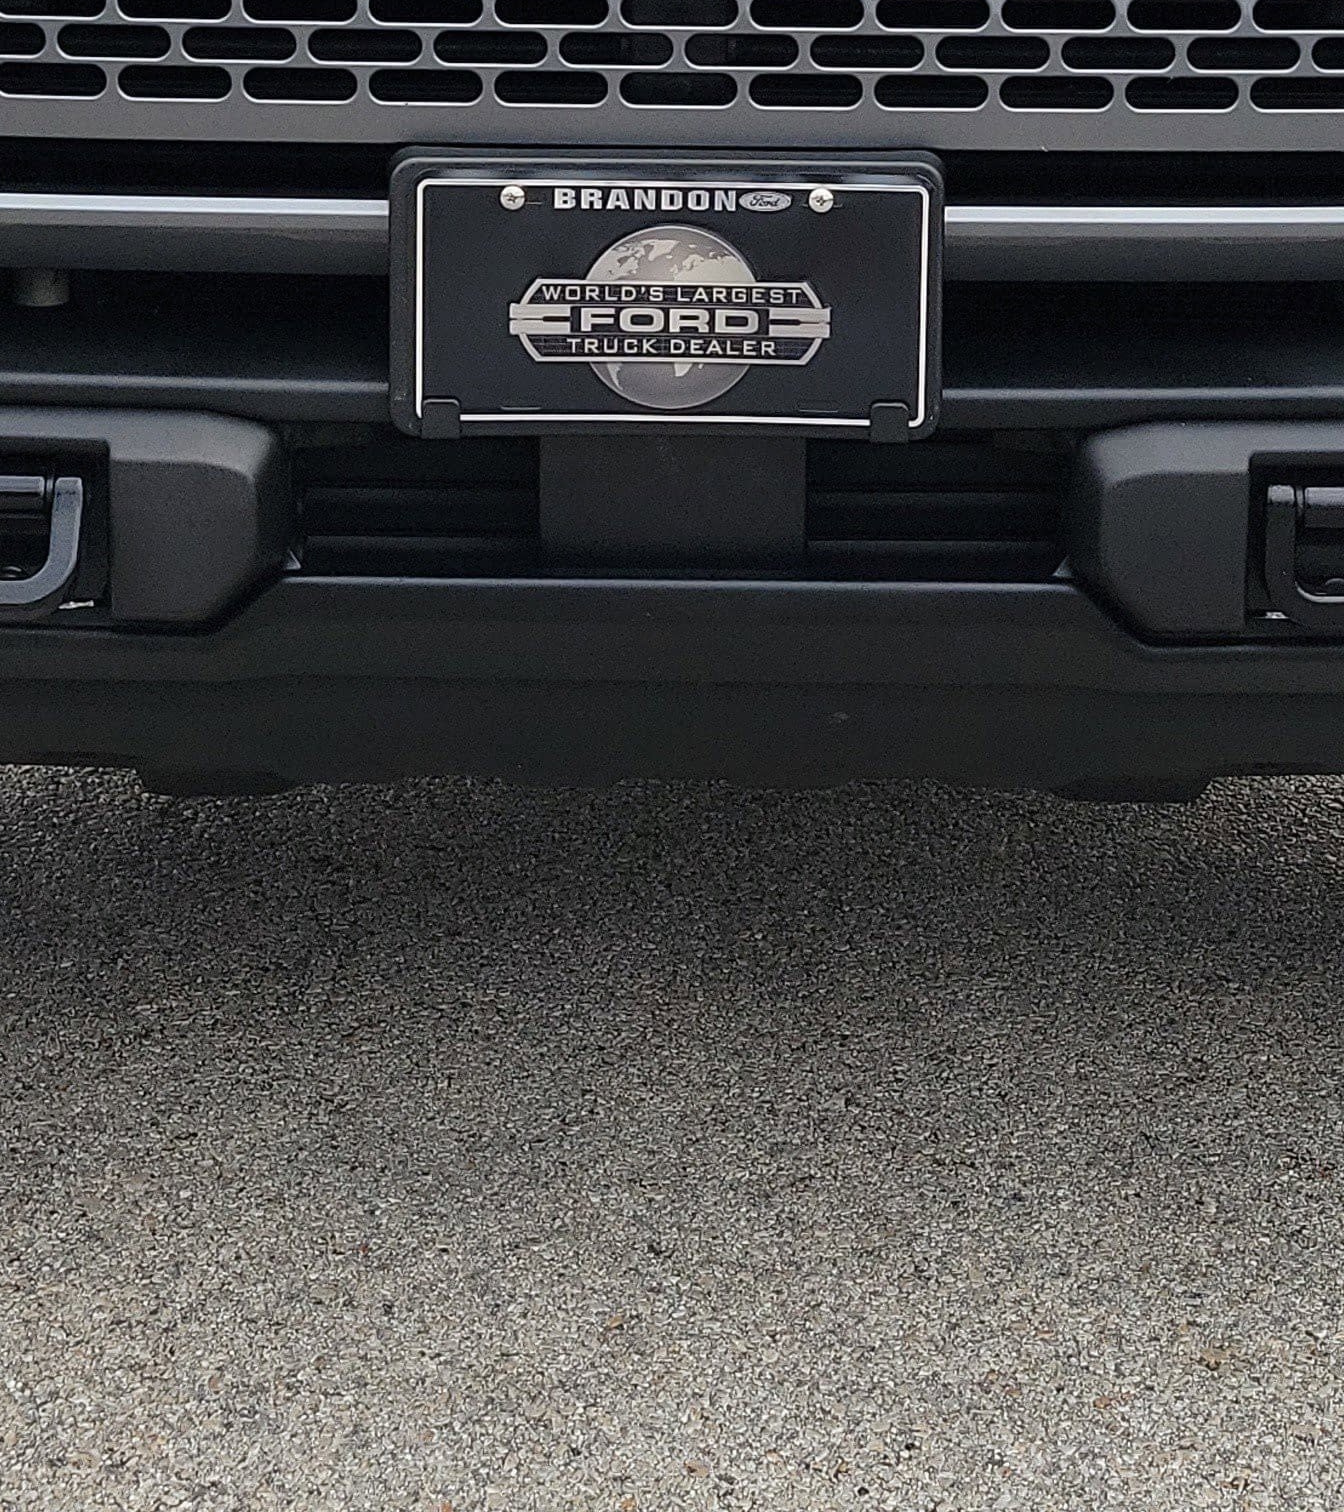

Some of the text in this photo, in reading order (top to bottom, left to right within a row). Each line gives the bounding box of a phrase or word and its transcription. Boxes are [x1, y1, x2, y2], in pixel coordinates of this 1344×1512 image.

[554, 188, 737, 210] BRANDON
[542, 285, 802, 304] WORLD'S LARGEST
[580, 308, 759, 333] FORD
[567, 338, 776, 356] TRUCK DEALER
